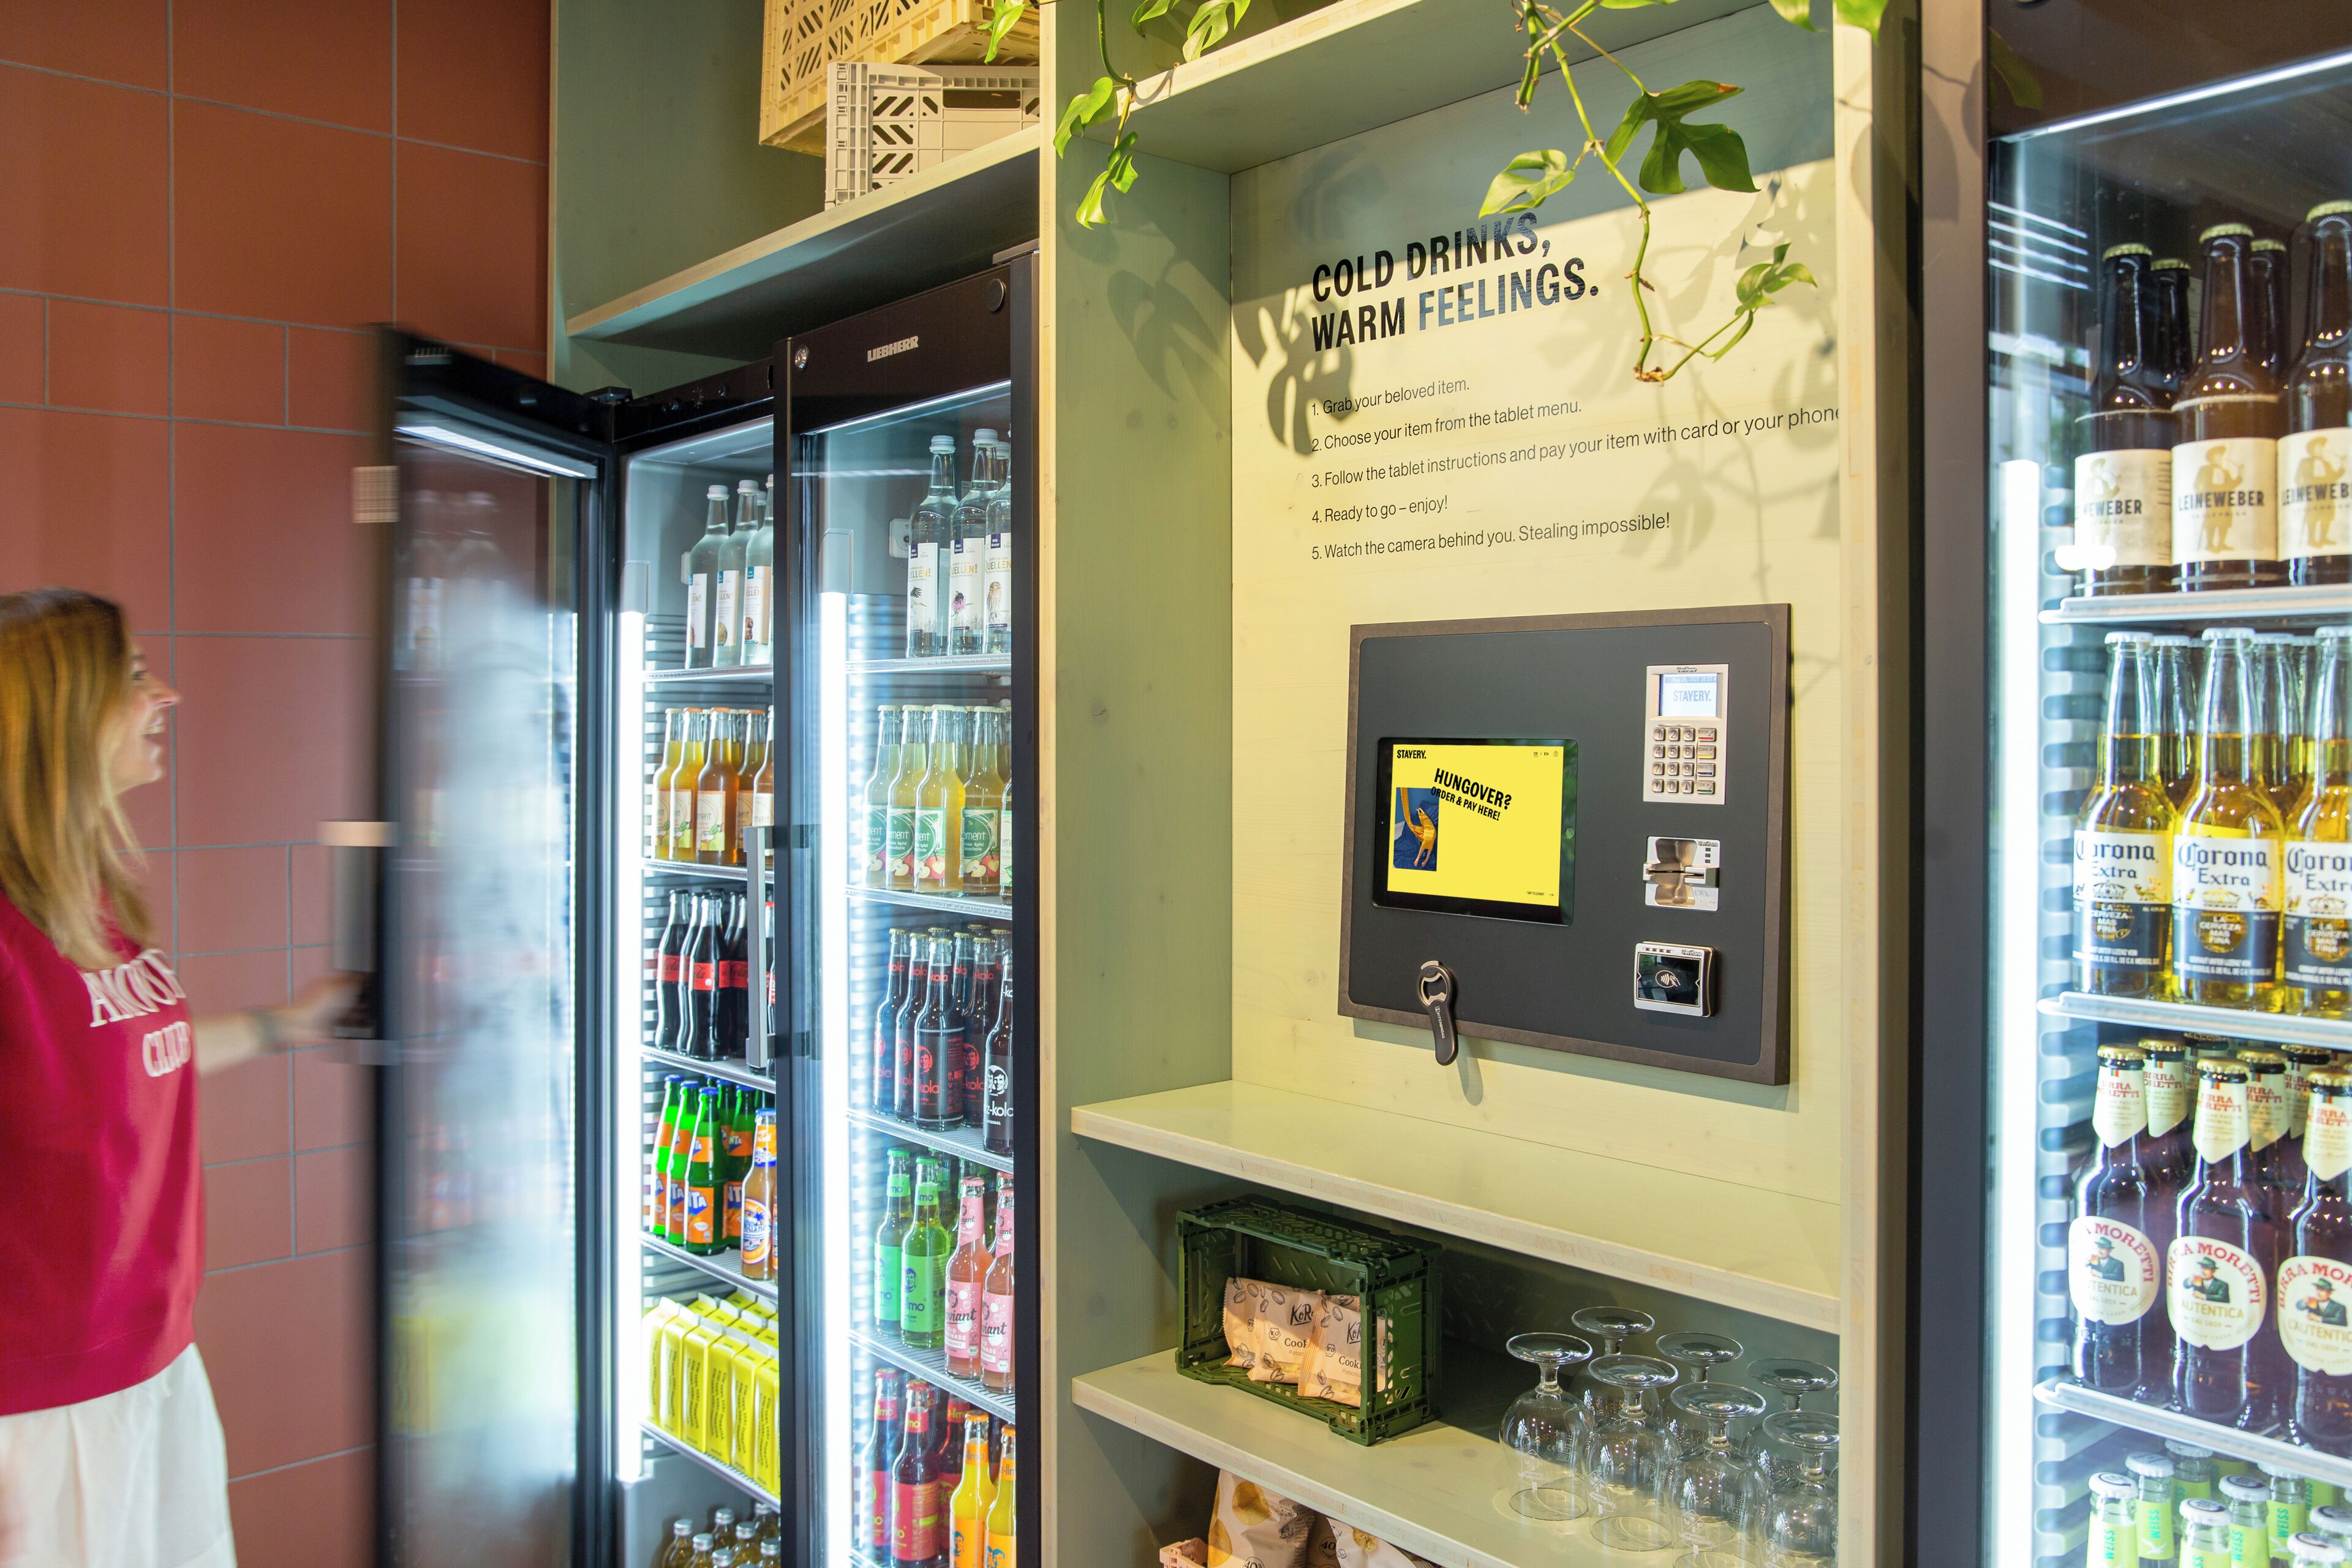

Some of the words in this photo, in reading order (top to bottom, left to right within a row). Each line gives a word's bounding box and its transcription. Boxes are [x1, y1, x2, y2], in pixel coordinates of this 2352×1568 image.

[1312, 249, 1395, 303] COLD
[1407, 212, 1551, 281] DRINKS,
[1311, 296, 1406, 352] WARM
[1419, 257, 1599, 331] FEELINGS.
[867, 335, 919, 363] LIEBHERR
[1311, 404, 1319, 416] 1.
[1323, 397, 1352, 415] Grab
[1355, 393, 1382, 412] your
[1385, 382, 1435, 404] beloved
[1438, 377, 1470, 397] item.
[1311, 439, 1322, 452] 2.
[1324, 429, 1371, 450] Choose
[1374, 425, 1401, 445] your
[1404, 421, 1432, 437] item
[1435, 417, 1466, 433] from
[1469, 412, 1491, 428] the
[1494, 404, 1535, 424] tablet
[1537, 400, 1581, 418] menu.
[1311, 474, 1322, 488] 3.
[1325, 469, 1363, 486] Follow
[1366, 465, 1386, 481] the
[1389, 460, 1425, 478] tablet
[1427, 450, 1507, 473] instructions
[1510, 444, 1536, 462] and
[1539, 442, 1566, 461] pay
[1569, 437, 1602, 458] your
[1606, 432, 1640, 450] item
[1643, 426, 1676, 445] with
[1681, 420, 1718, 440] card
[1722, 420, 1741, 435] or
[1744, 413, 1784, 435] your
[2179, 491, 2264, 511] LEINEWEBER
[2282, 483, 2352, 506] LEINEWEB
[1311, 510, 1322, 524] 4.
[1325, 504, 1363, 523] Ready
[1365, 503, 1378, 518] to
[1381, 502, 1396, 519] go
[1409, 495, 1448, 514] enjoy!
[1311, 546, 1322, 560] 5.
[1324, 541, 1362, 559] Watch
[1365, 540, 1385, 555] the
[1387, 538, 1436, 554] camera
[1439, 530, 1483, 549] behind
[1487, 529, 1516, 547] you.
[1518, 522, 1578, 540] Stealing
[1581, 512, 1670, 537] impossible!
[951, 564, 978, 575] UELLEN!
[1673, 690, 1711, 701] STAYERY.
[1397, 749, 1427, 759] STAYERY.
[1434, 767, 1512, 810] HUNGOVER?
[1431, 786, 1455, 804] ORDER
[1456, 796, 1463, 806] &
[1463, 799, 1477, 812] PAY
[1477, 804, 1501, 821] HERE!
[2178, 842, 2268, 870] Corona
[2287, 847, 2352, 876] Coro
[2198, 868, 2250, 886] Extra
[2144, 1079, 2183, 1088] ORETTI
[2095, 1223, 2154, 1283] MORETTI
[2197, 1242, 2261, 1304] MORETTI
[2312, 1262, 2352, 1290] MOR
[2089, 1280, 2138, 1297] TENTICA
[946, 1308, 978, 1322] viant
[1290, 1303, 1314, 1326] KoR
[2181, 1299, 2244, 1319] AUTENTICA
[2148, 1509, 2162, 1539] WEISS
[2276, 1508, 2290, 1539] WEISS
[1321, 1540, 1336, 1551] 40
[2104, 1529, 2115, 1560] WEISS
[2232, 1529, 2244, 1561] WEISS
